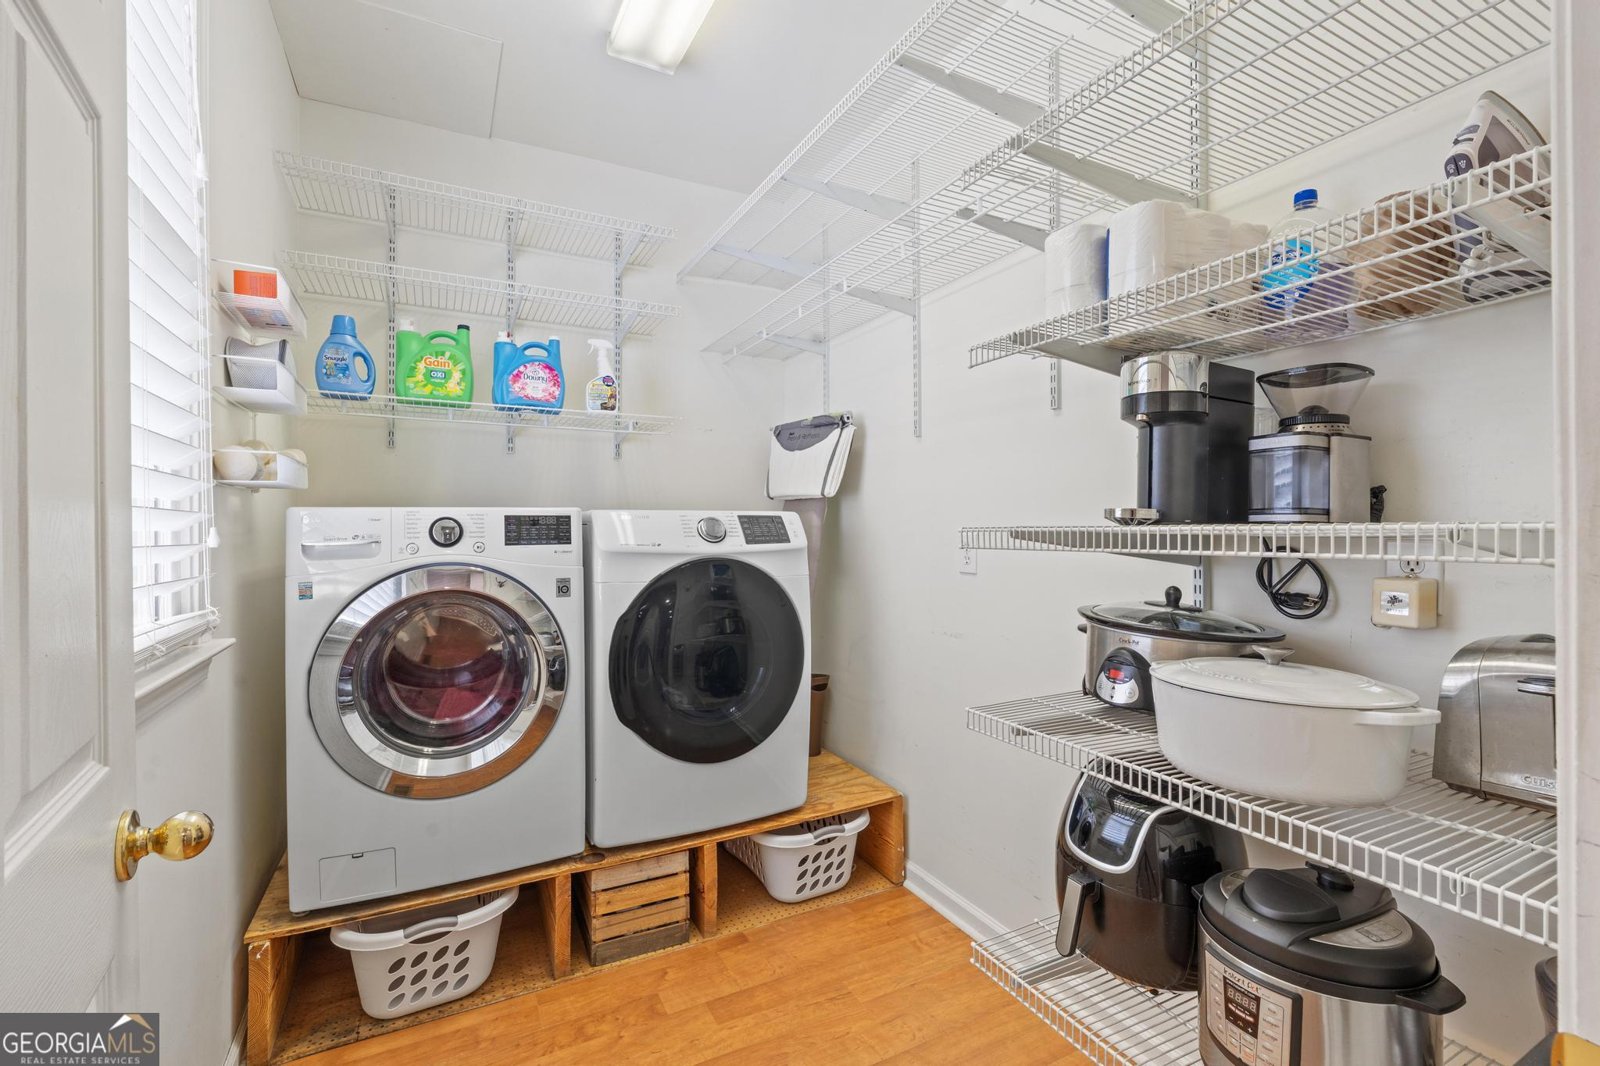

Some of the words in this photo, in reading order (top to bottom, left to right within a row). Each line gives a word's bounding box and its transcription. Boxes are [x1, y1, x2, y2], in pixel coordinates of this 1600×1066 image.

[423, 355, 451, 369] Gain
[430, 371, 446, 379] OXI
[523, 373, 547, 384] Downy
